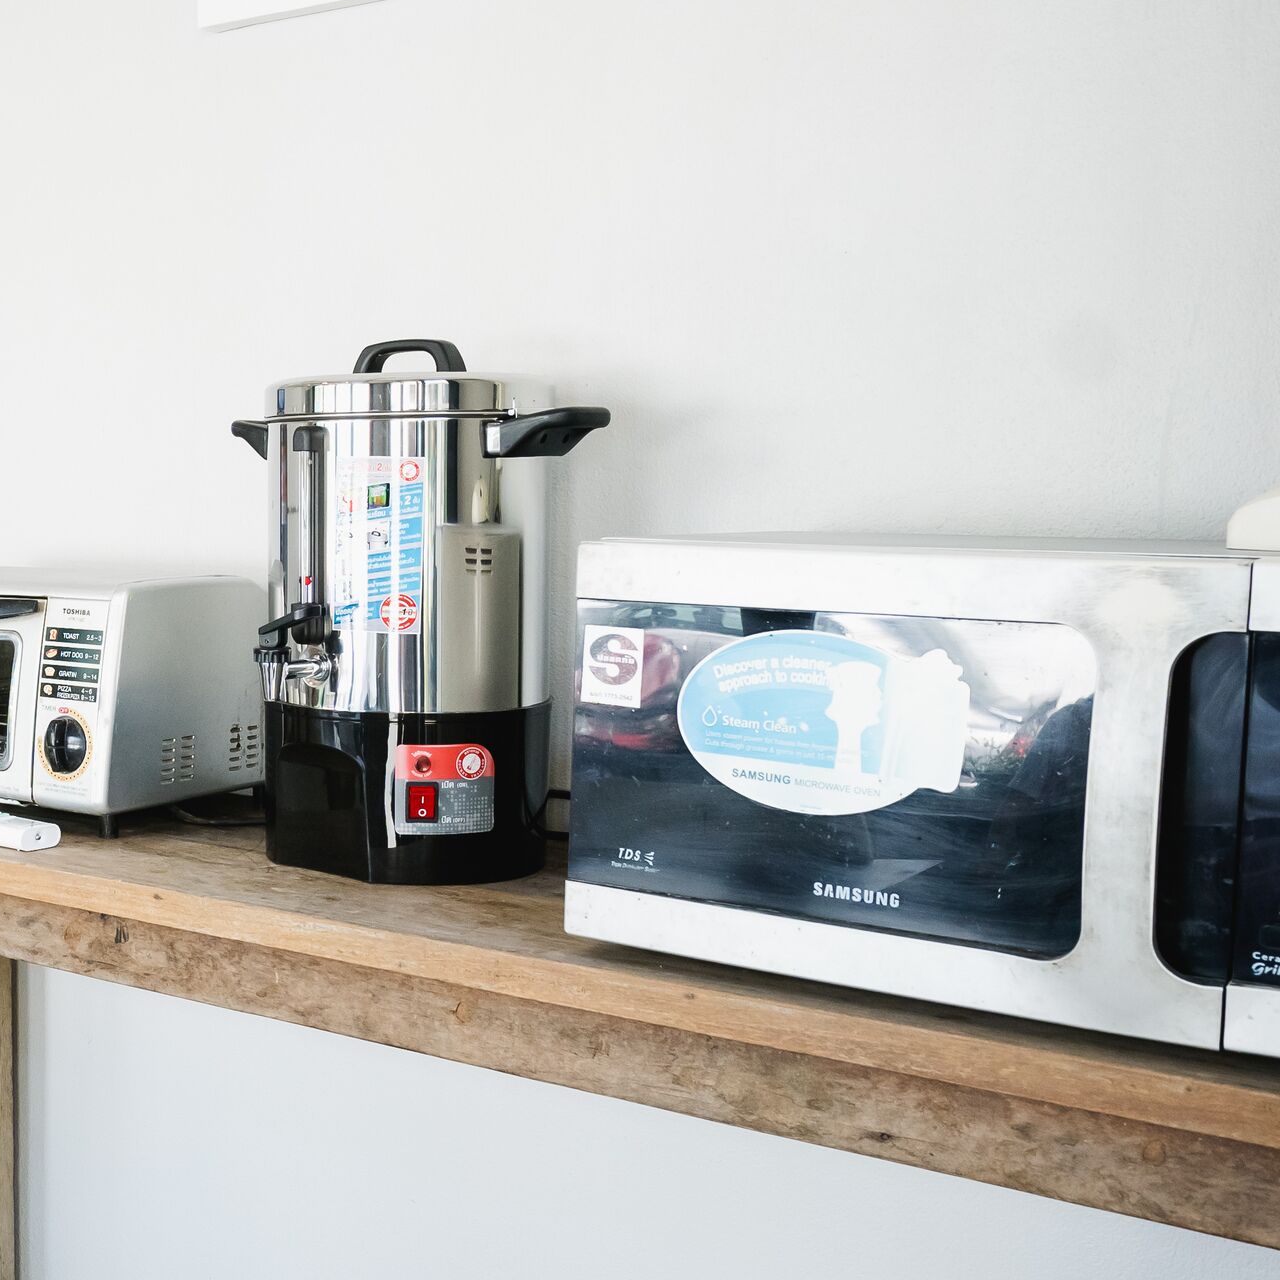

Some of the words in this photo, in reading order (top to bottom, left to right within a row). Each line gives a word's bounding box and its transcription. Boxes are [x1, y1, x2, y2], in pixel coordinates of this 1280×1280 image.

[63, 608, 91, 617] TOSHIBA
[63, 632, 80, 640] TOAST
[72, 651, 84, 659] DOG
[713, 657, 767, 678] Discover
[770, 657, 780, 669] a
[58, 671, 77, 679] GRATIN
[719, 671, 772, 693] approach
[775, 671, 787, 683] to
[57, 685, 72, 693] PIZZA
[722, 714, 760, 730] Steam
[763, 718, 797, 734] Clean
[732, 768, 791, 785] SAMSUNG
[794, 778, 851, 794] MICROWAVE
[853, 786, 881, 797] OVEN
[813, 881, 900, 908] SAMSUNG
